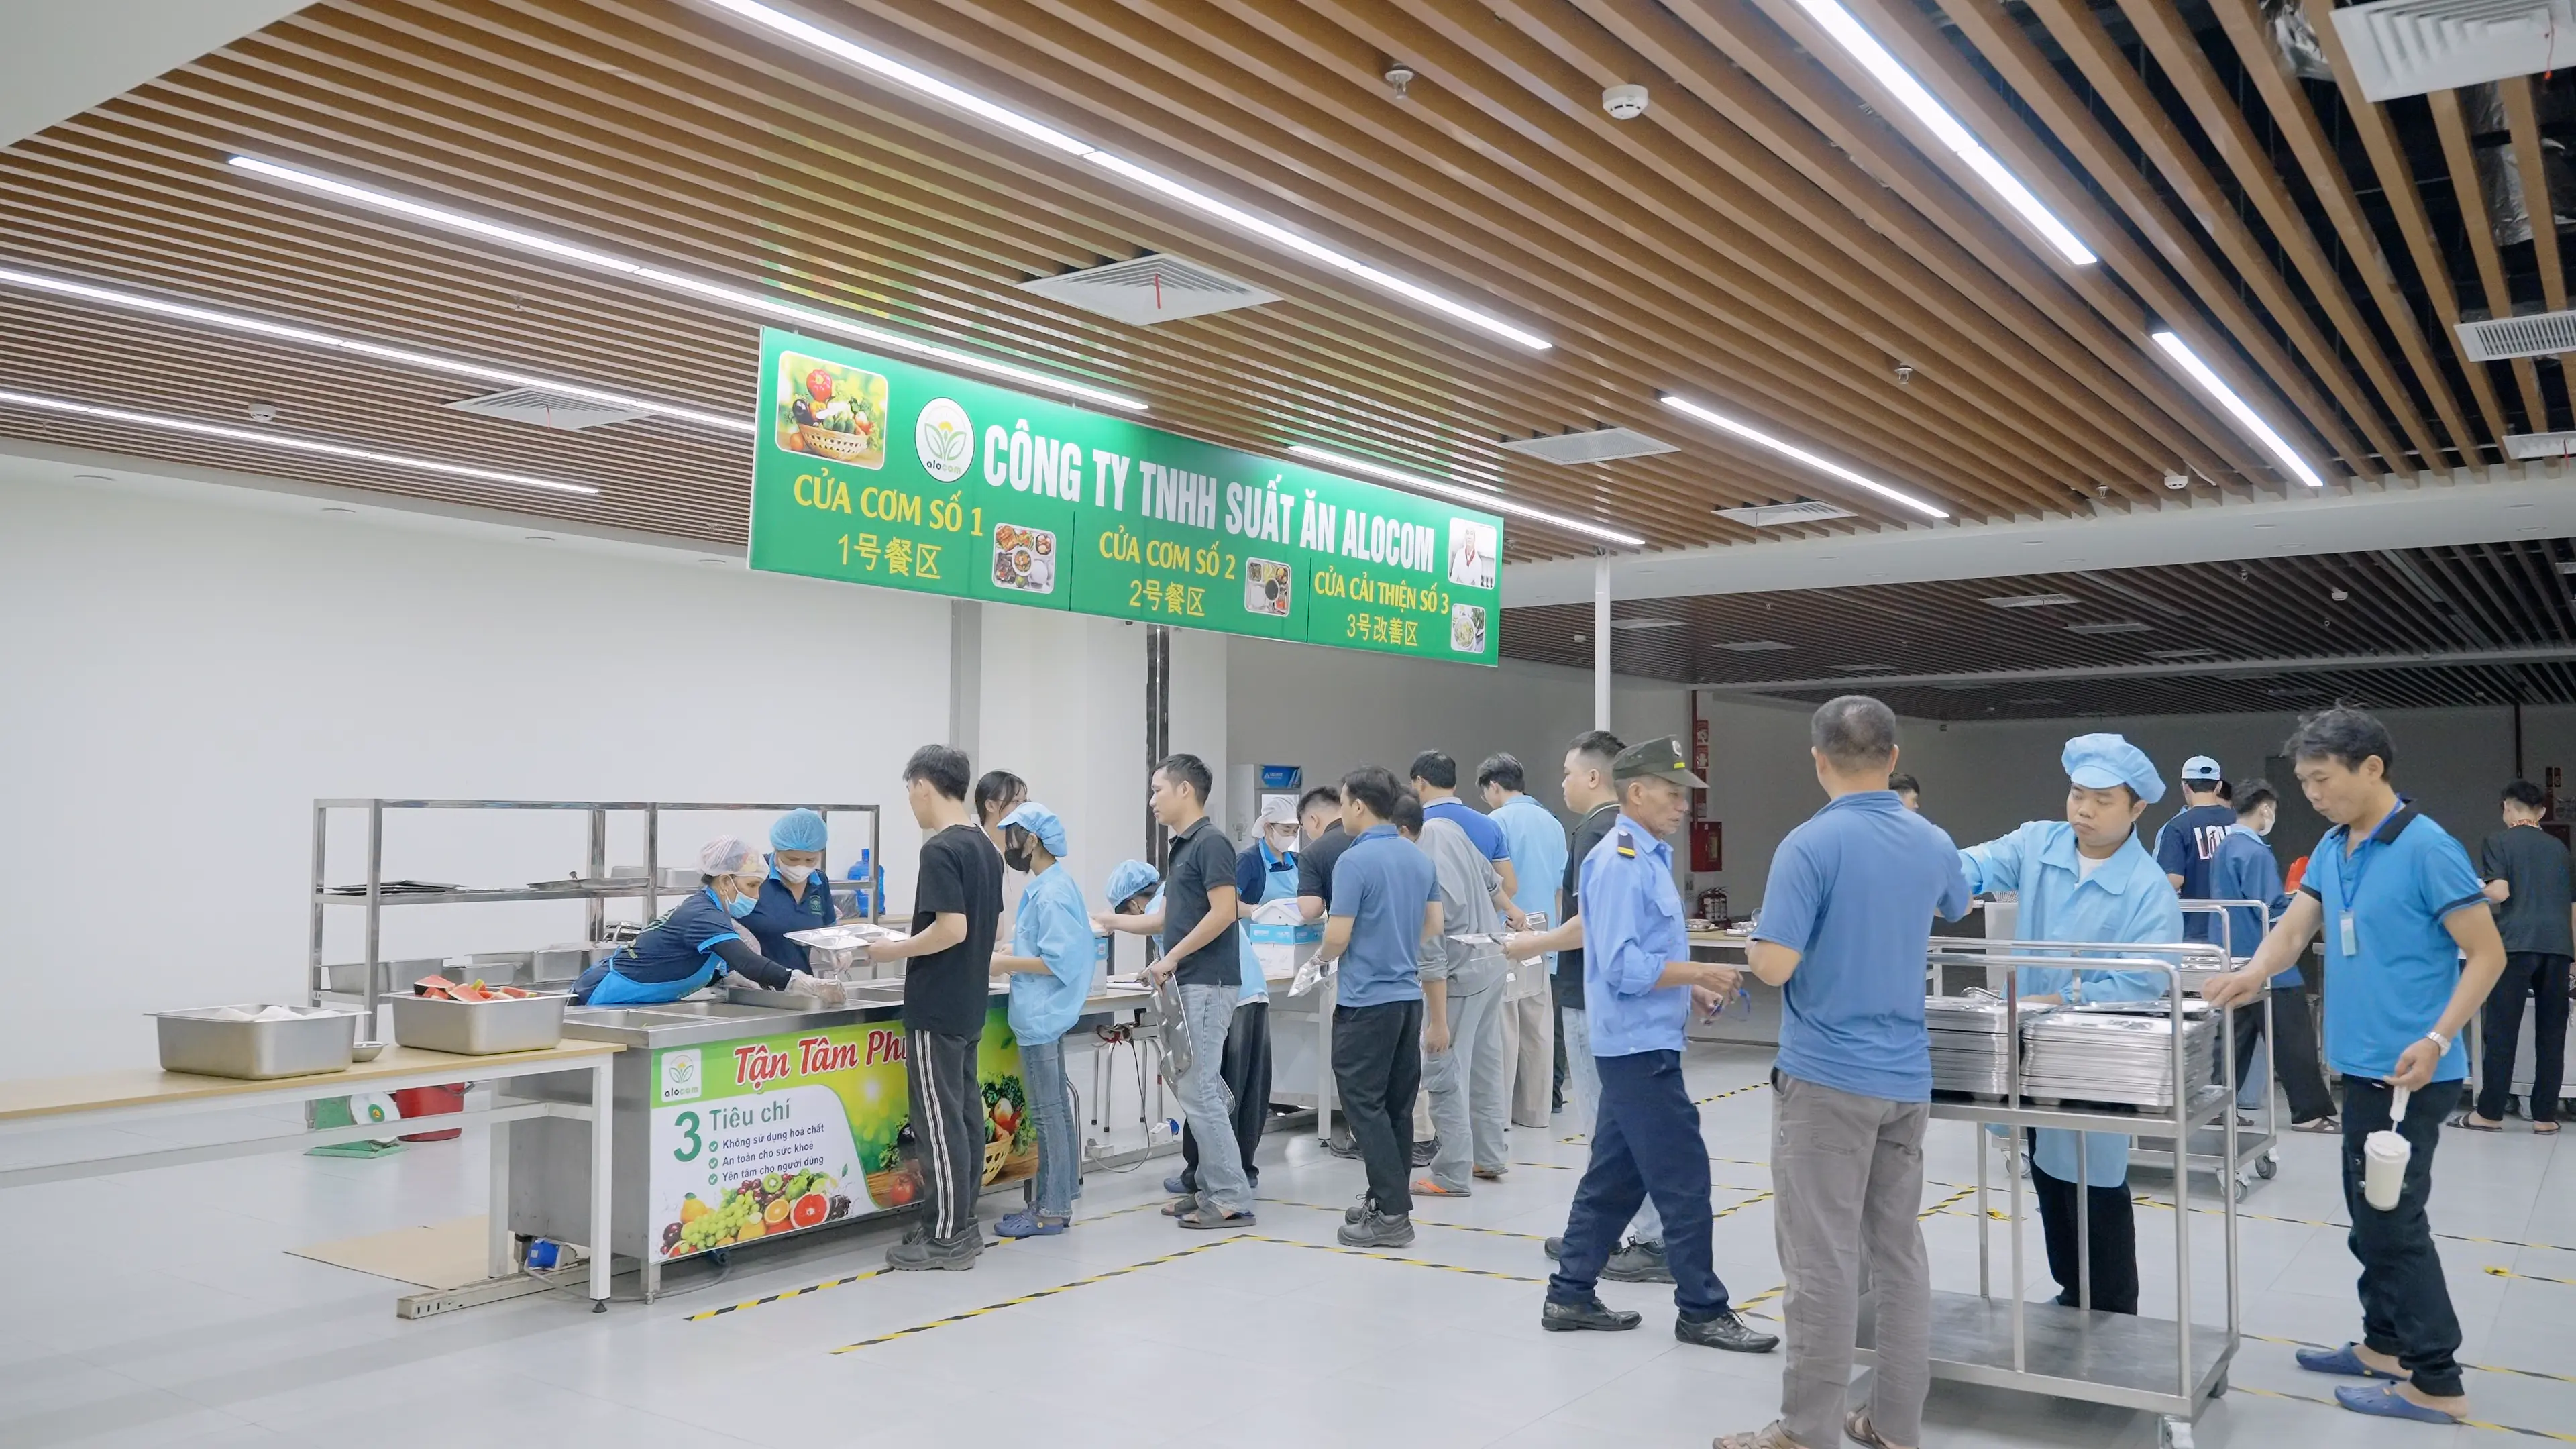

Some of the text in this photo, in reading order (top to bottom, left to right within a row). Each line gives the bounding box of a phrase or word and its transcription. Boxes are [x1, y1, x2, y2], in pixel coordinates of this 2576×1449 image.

[926, 460, 961, 474] alocom
[794, 466, 983, 536] CỬA CƠM SỐ 1
[983, 418, 1434, 573] CÔNG TY TNHH SUẤT ĂN ALOCOM
[837, 532, 942, 580] 1号餐区
[1099, 525, 1236, 580] CỬA CƠM SỐ 2
[1129, 580, 1205, 617] 2号餐区
[1314, 565, 1449, 614] CỬA CẢI THIỆN SỐ 3
[1346, 614, 1419, 647] 3号改善区
[735, 1030, 906, 1089] Tận Tâm Ph
[664, 1086, 699, 1097] alocom
[673, 1098, 790, 1163] 3 Tiêu chí
[722, 1137, 751, 1150] Không
[767, 1132, 788, 1143] dụng
[722, 1157, 735, 1167] An
[758, 1149, 773, 1161] cho
[722, 1171, 739, 1182] Yên
[741, 1168, 757, 1179] tâm
[759, 1164, 775, 1175] cho
